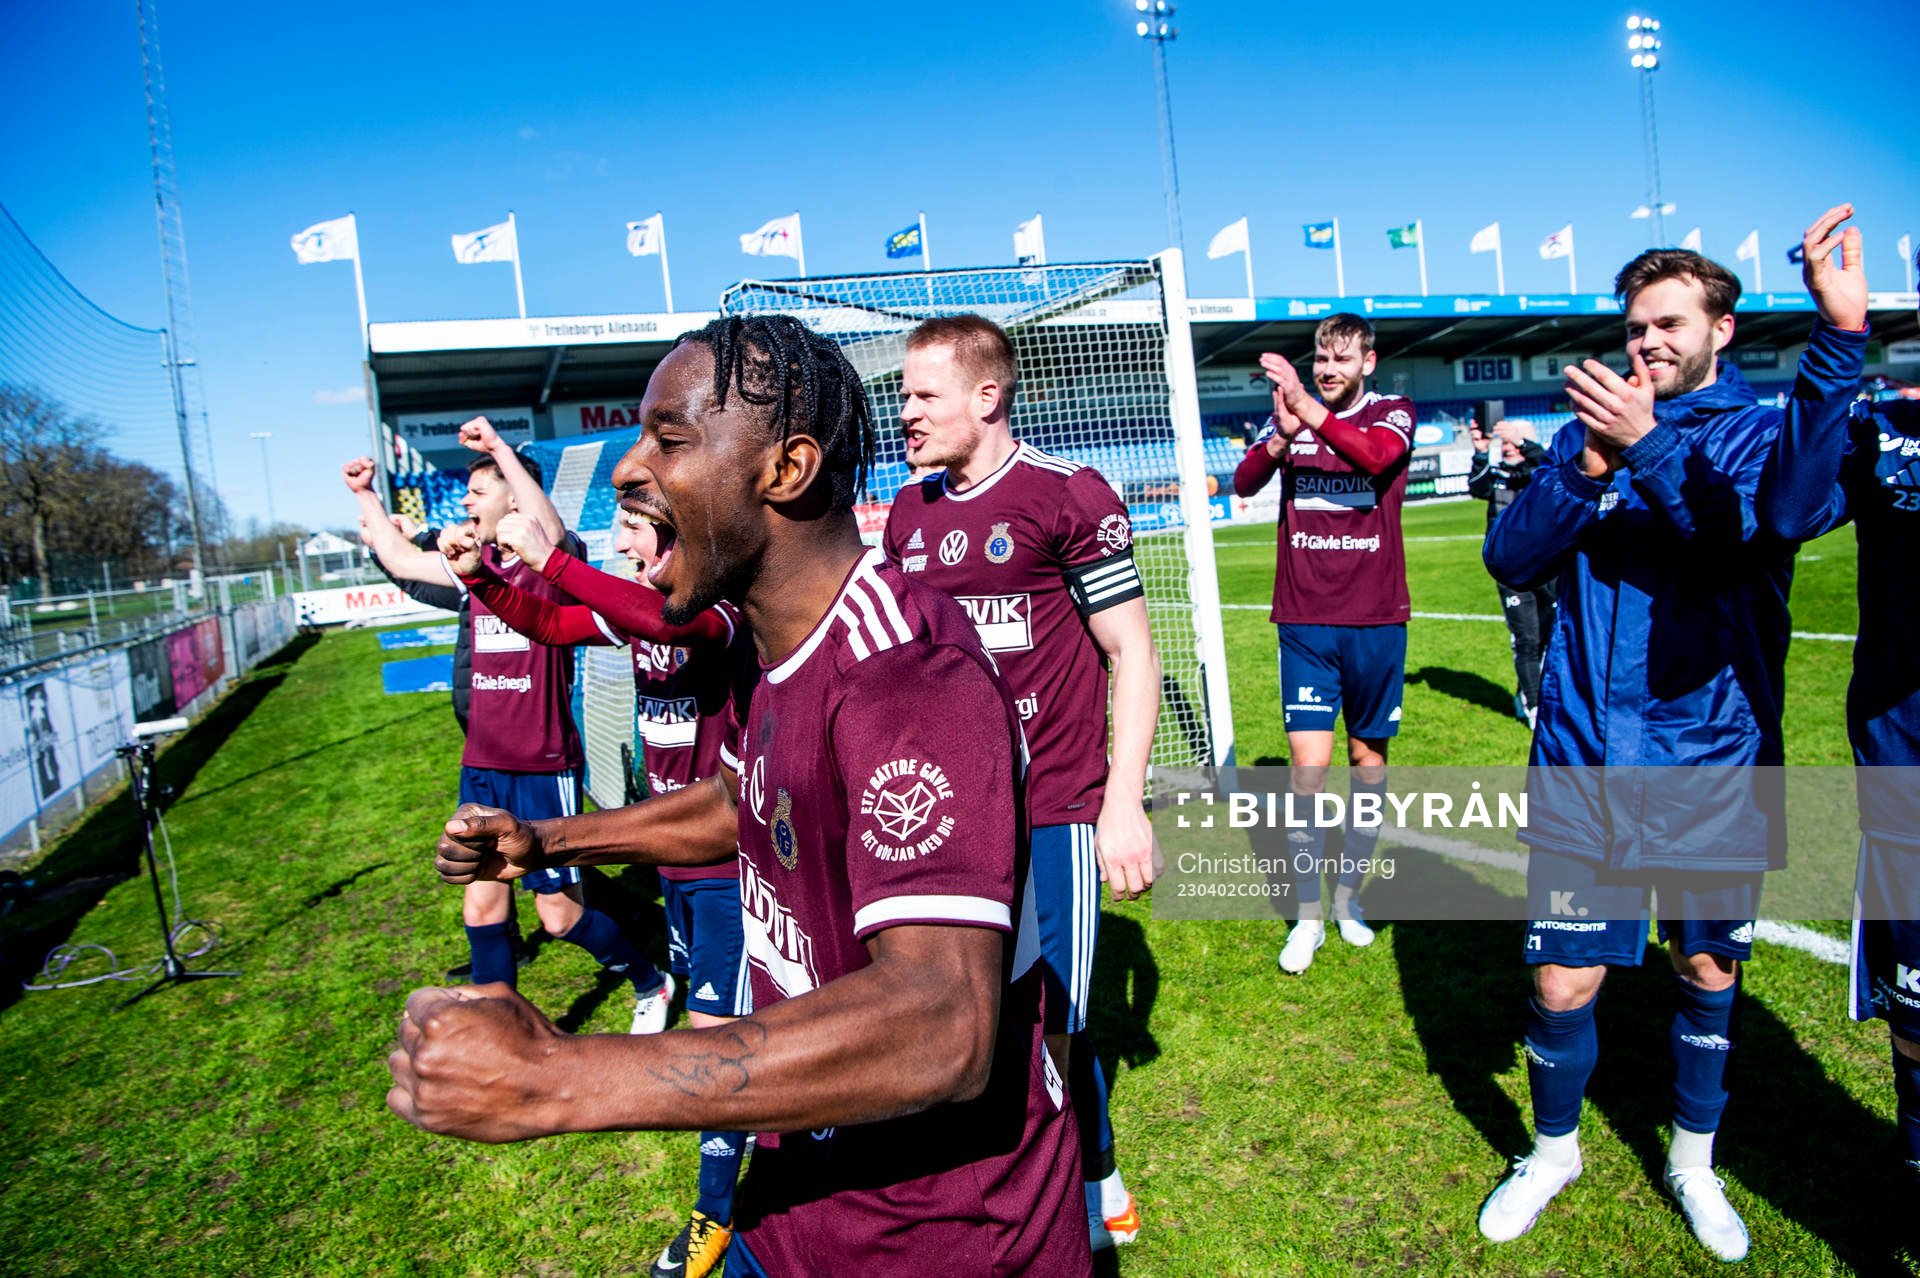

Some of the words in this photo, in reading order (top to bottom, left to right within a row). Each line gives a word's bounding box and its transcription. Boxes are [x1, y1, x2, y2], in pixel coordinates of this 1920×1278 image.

[545, 323, 604, 336] Trelleborgs
[580, 405, 641, 429] MAX
[421, 422, 461, 436] Trelleb
[1295, 476, 1374, 493] SANDVIK
[1307, 535, 1341, 550] Gävle
[1342, 534, 1380, 552] Energi
[961, 597, 1024, 624] DVIK
[498, 675, 531, 692] Energi
[1298, 687, 1321, 703] K.
[861, 789, 876, 815] ETT
[869, 759, 918, 791] BÄTTRE
[919, 762, 954, 800] GÄVLE
[861, 829, 879, 852] DET
[874, 844, 917, 862] BÖRJAR
[916, 833, 943, 856] MED
[936, 815, 955, 838] DIG
[1550, 890, 1589, 917] K.
[1533, 920, 1607, 932] NTORSCENTER
[1681, 1034, 1730, 1051] adida
[700, 1145, 736, 1157] adidas
